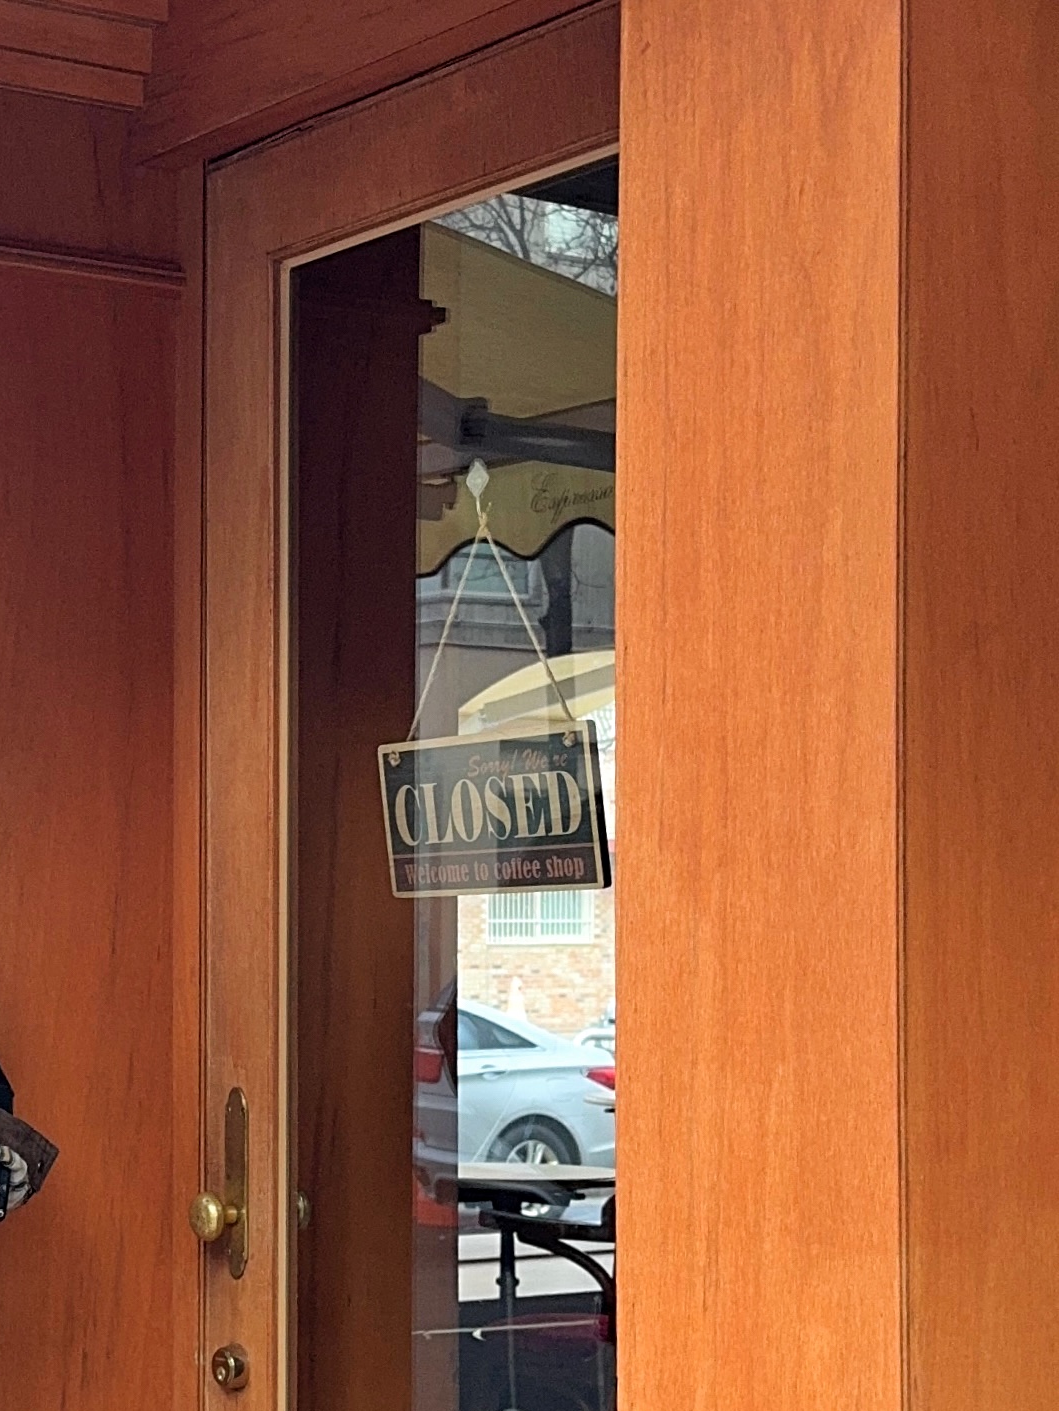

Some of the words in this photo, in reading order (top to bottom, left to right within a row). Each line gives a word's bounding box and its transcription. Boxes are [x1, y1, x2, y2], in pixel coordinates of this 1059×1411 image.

[395, 770, 582, 846] CLOSED
[405, 863, 469, 885] Welcome
[474, 860, 489, 881] to
[494, 857, 542, 880] coffee
[546, 855, 585, 879] shop
